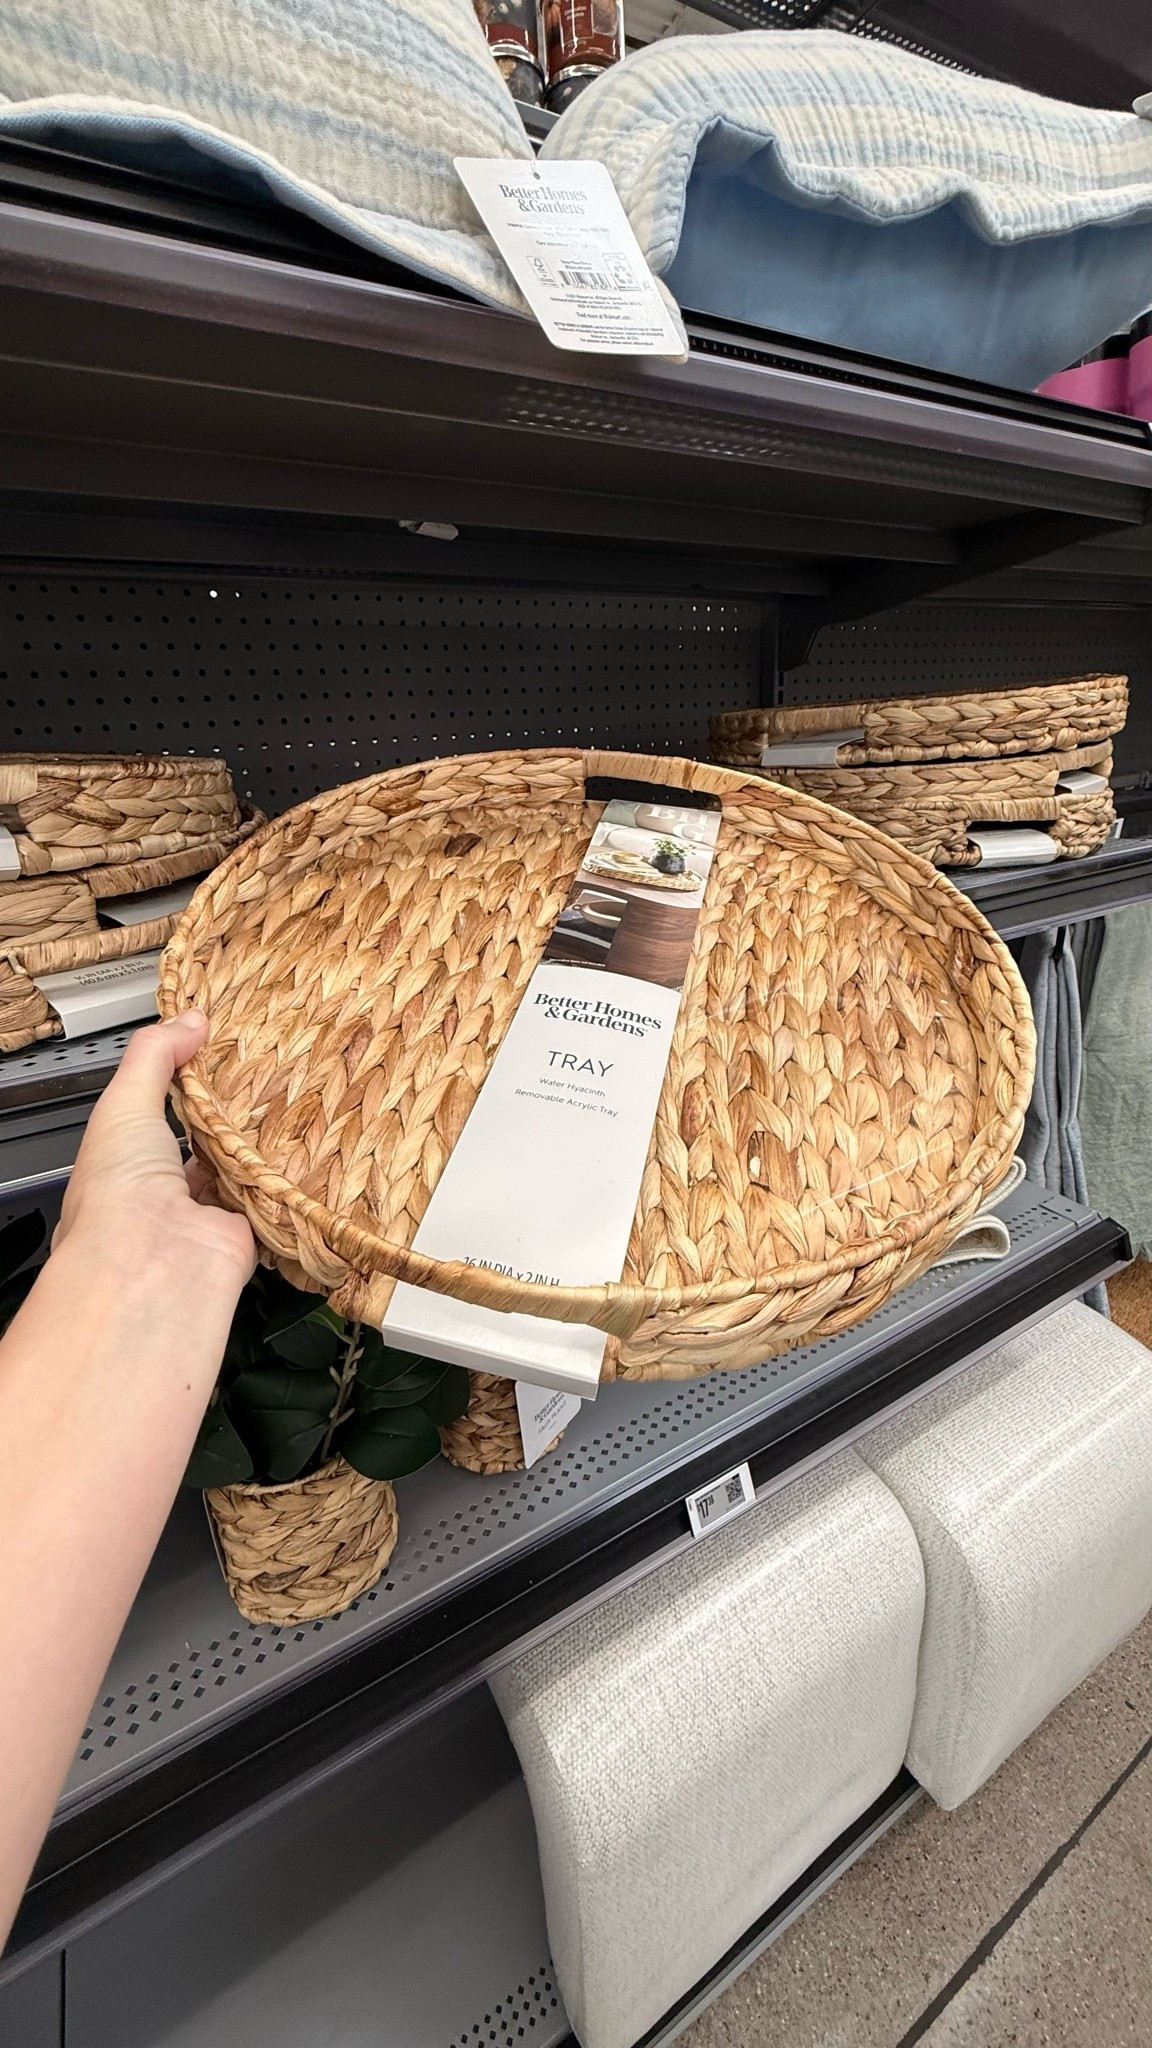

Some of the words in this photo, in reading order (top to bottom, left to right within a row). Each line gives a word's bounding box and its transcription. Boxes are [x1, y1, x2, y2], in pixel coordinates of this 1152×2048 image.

[498, 184, 540, 199] Better
[539, 187, 587, 201] Homes
[529, 199, 585, 214] Gardens
[96, 968, 114, 976] DIA
[533, 993, 593, 1010] Better
[593, 1001, 662, 1030] Homes
[562, 1008, 646, 1037] Gardens
[548, 1050, 615, 1078] TRAY
[539, 1077, 565, 1088] Water
[567, 1082, 606, 1098] Hyacinth
[515, 1088, 565, 1104] Removable
[566, 1098, 597, 1111] Acrylic
[600, 1106, 618, 1118] Tray
